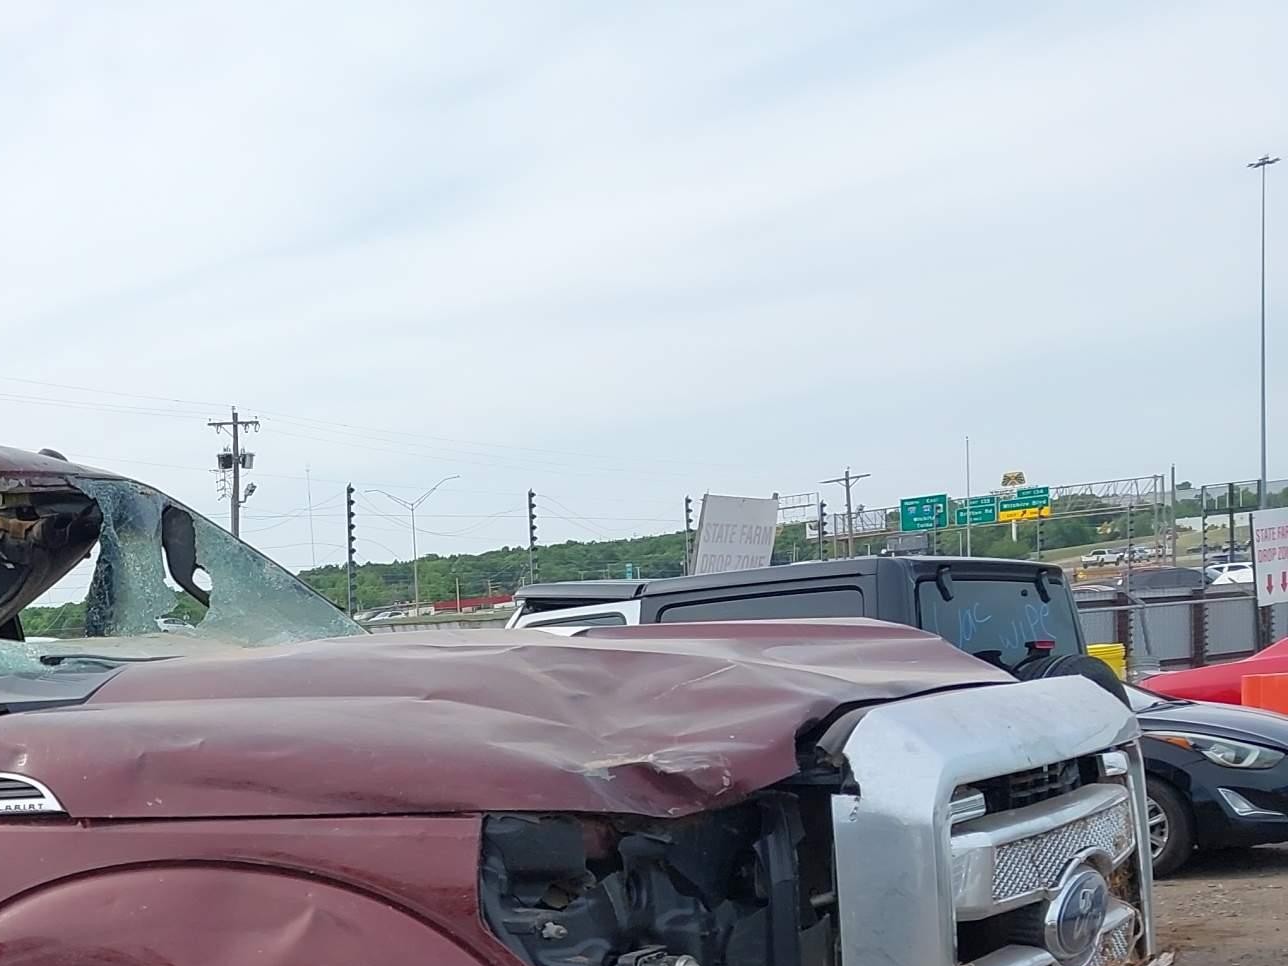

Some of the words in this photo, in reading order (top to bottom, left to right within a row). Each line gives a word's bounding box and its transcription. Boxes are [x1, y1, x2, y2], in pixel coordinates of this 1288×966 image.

[703, 522, 738, 544] STATE
[739, 523, 773, 545] FARM
[1256, 527, 1276, 543] STATE
[700, 553, 732, 573] DROP
[735, 555, 767, 569] ZONE
[1257, 547, 1277, 562] DROP
